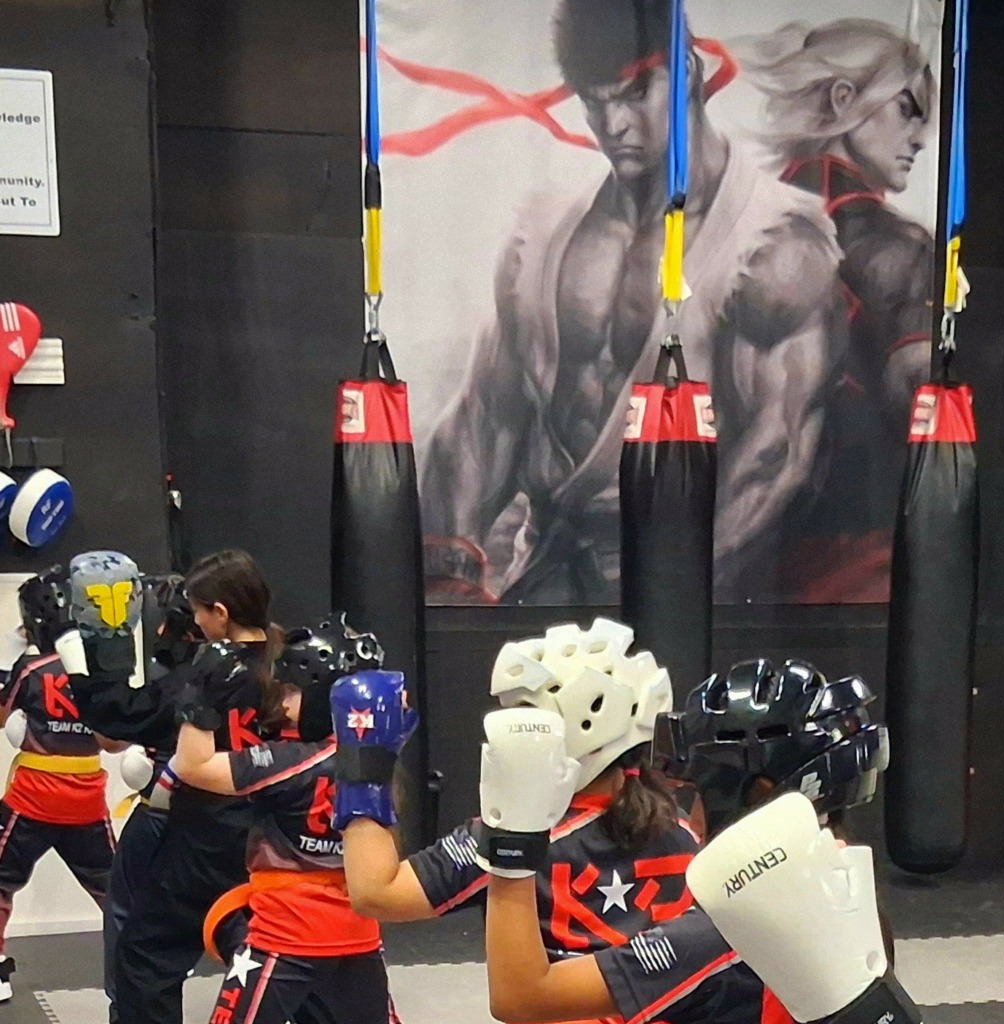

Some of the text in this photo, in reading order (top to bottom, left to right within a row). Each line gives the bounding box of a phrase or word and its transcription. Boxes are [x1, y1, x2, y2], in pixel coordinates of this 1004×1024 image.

[20, 197, 37, 207] To
[47, 720, 71, 733] TEAM
[509, 723, 552, 735] CENTURY
[299, 835, 331, 854] TEAM
[721, 847, 788, 898] CENTURY
